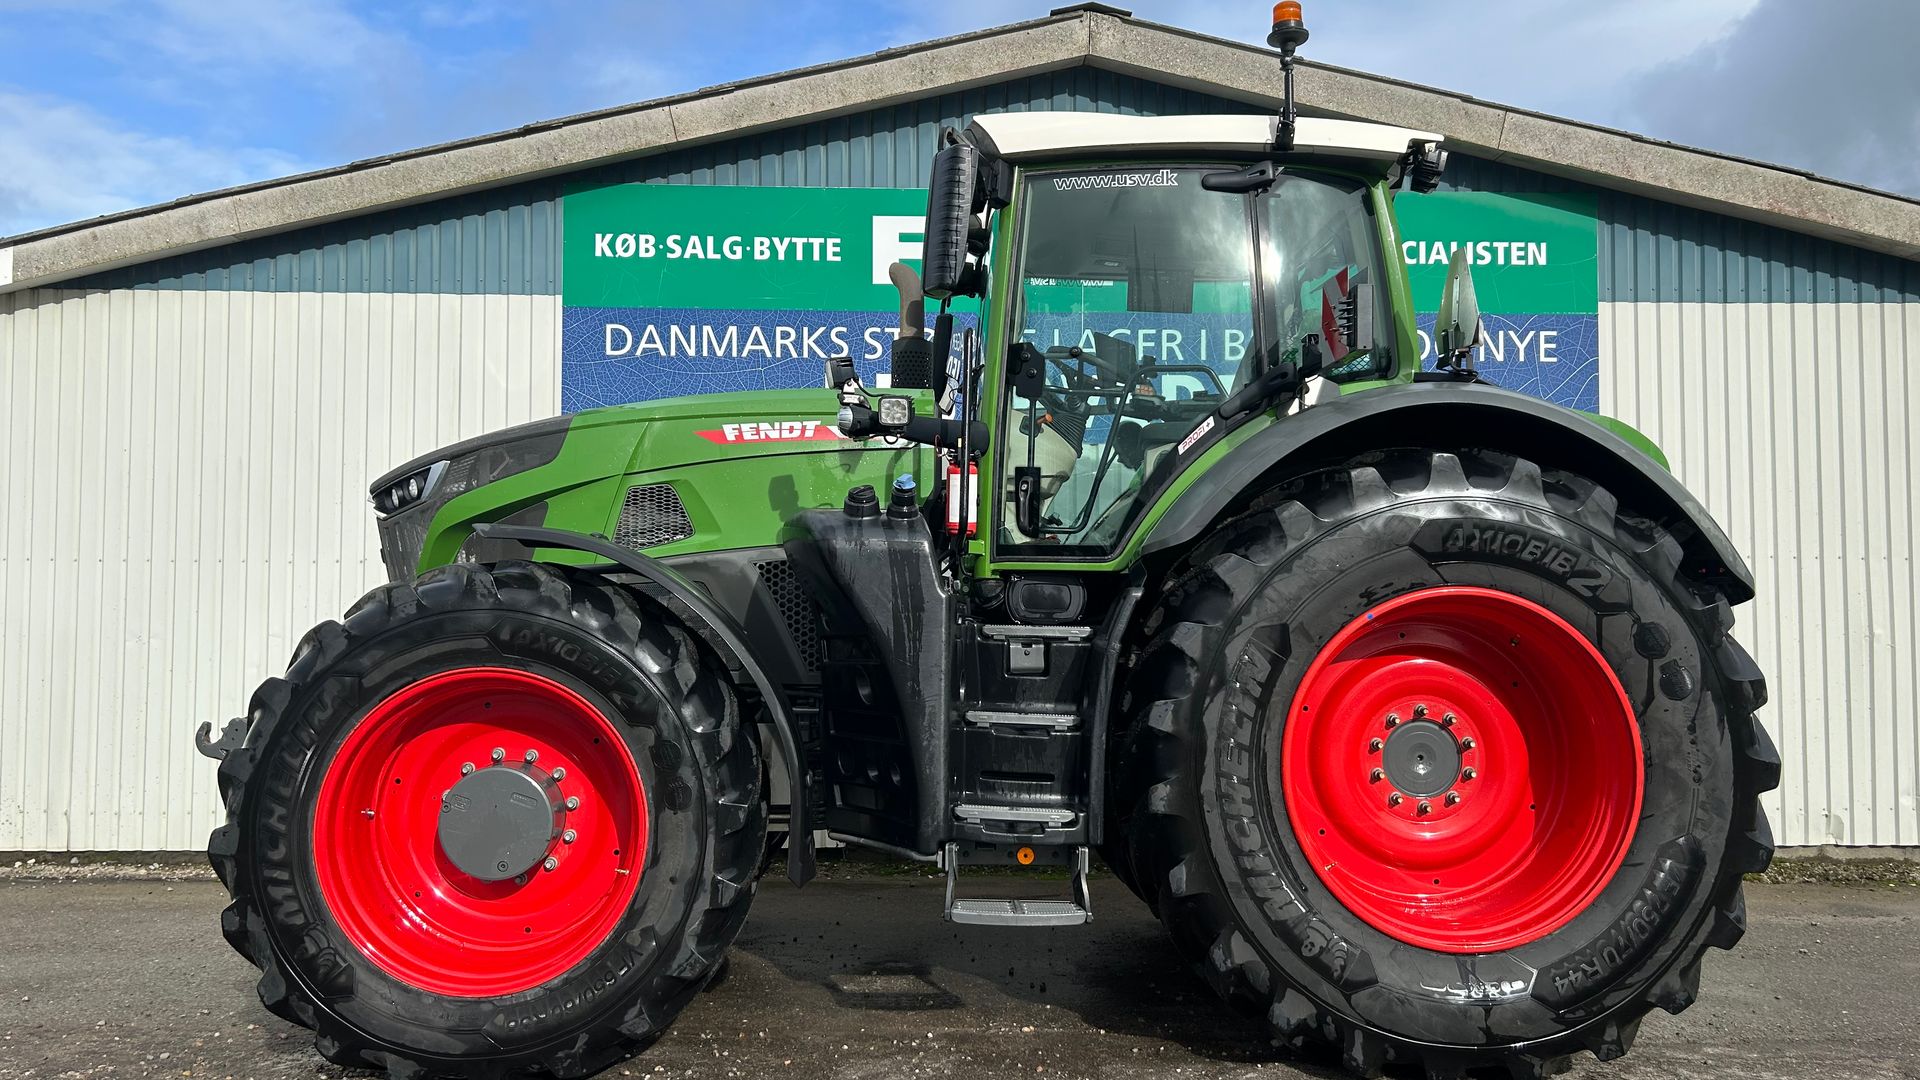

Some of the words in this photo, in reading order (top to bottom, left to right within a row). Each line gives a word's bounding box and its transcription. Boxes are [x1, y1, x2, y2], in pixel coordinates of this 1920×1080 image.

[1053, 169, 1178, 191] www.usv.dk
[604, 324, 850, 359] DANMARKS
[1479, 330, 1558, 363] NYE
[722, 420, 821, 441] FENDT
[1218, 641, 1307, 921] MICHELIN
[261, 686, 337, 925] MICHELIN
